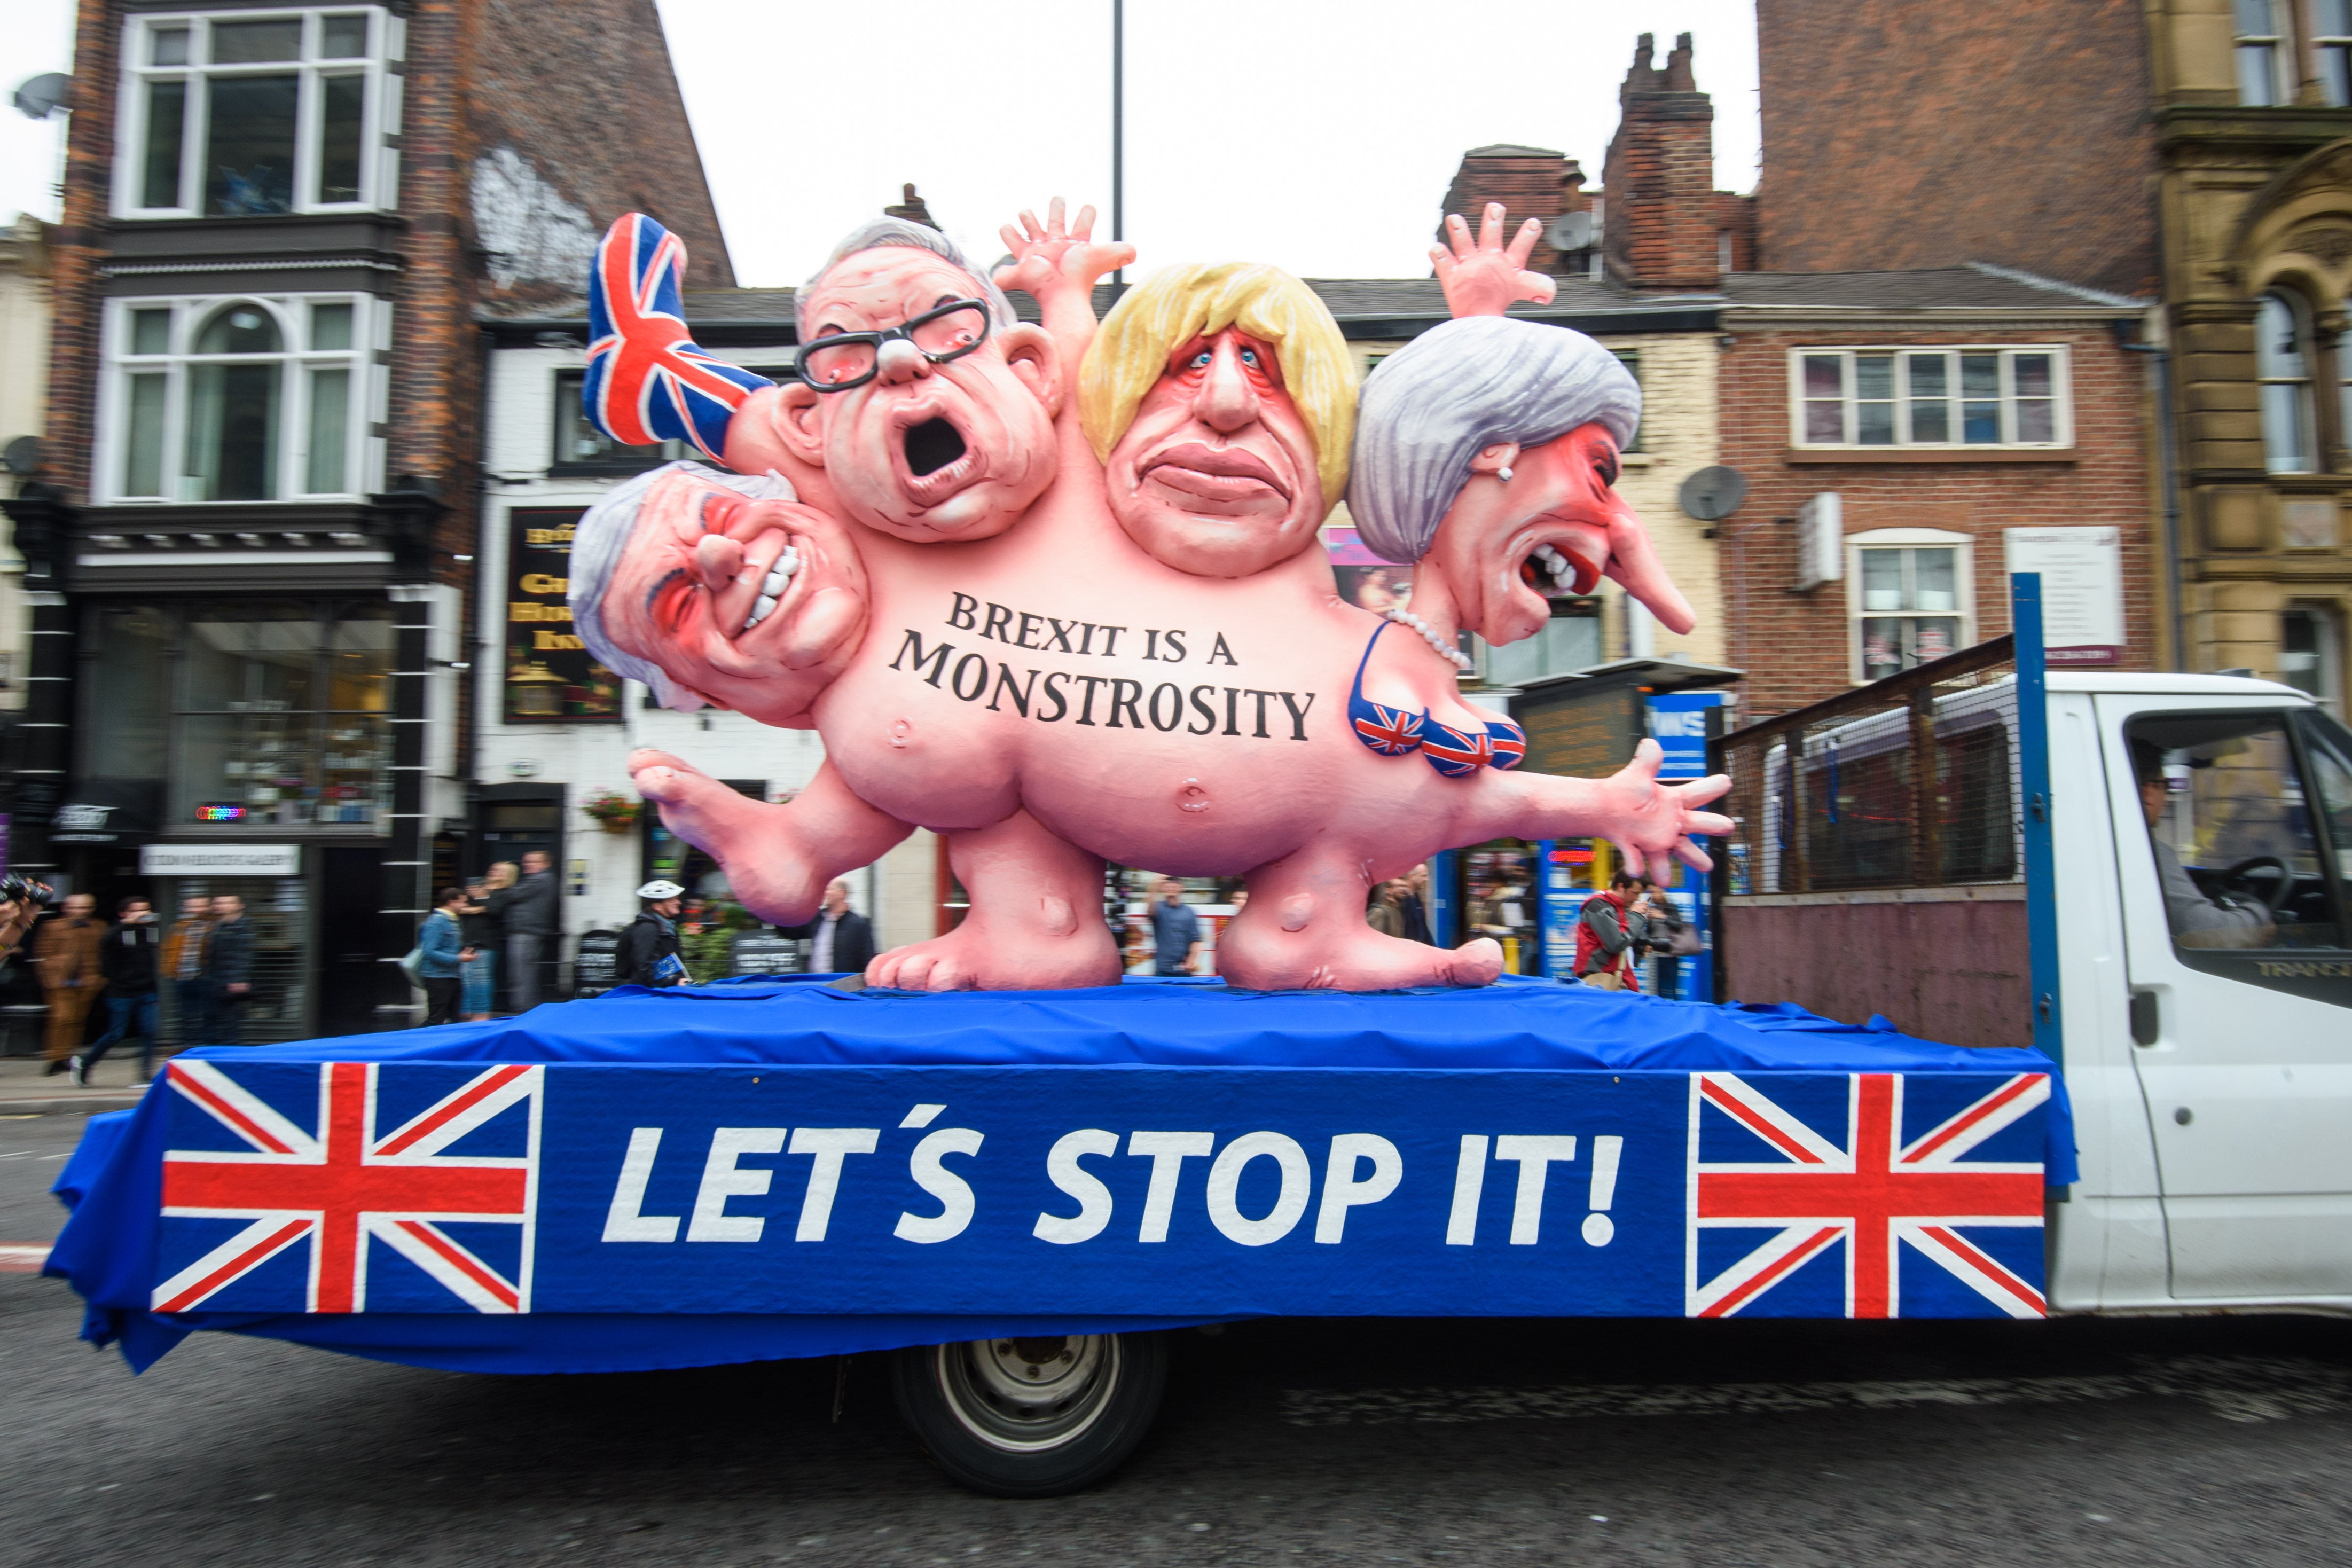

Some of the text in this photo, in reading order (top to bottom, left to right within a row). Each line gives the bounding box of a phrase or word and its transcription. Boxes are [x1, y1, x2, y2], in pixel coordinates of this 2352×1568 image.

[945, 591, 1238, 666] BREXIT IS A
[889, 629, 1315, 741] MONSTROSITY
[1032, 1128, 1404, 1246] STOP
[1446, 1134, 1624, 1247] IT!
